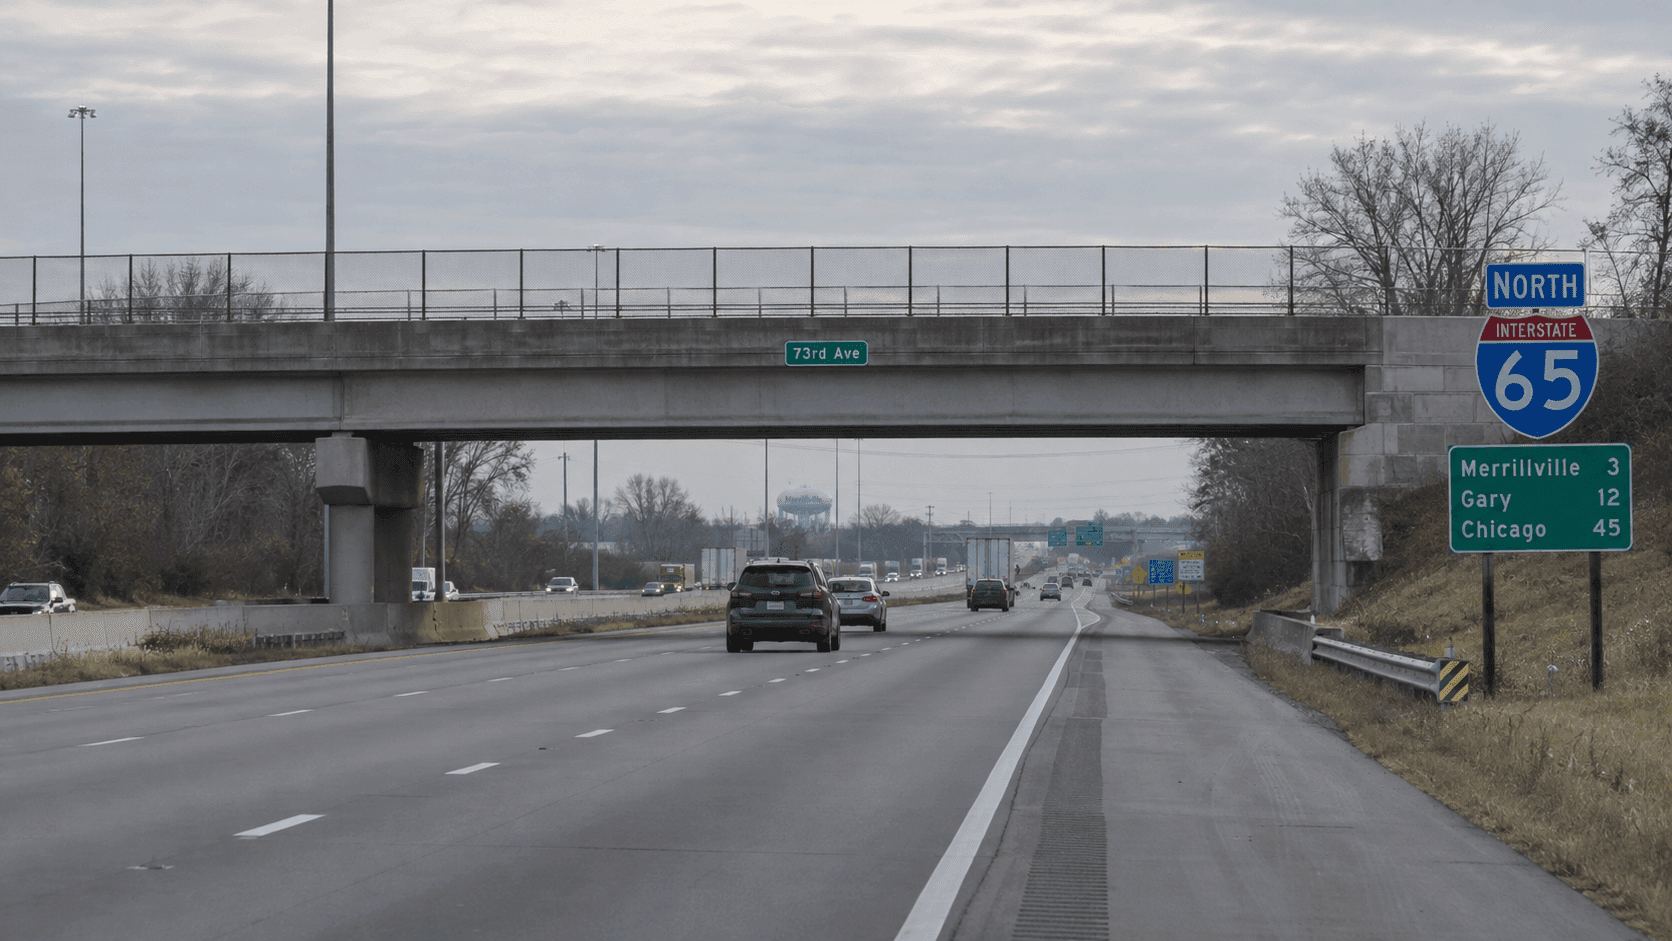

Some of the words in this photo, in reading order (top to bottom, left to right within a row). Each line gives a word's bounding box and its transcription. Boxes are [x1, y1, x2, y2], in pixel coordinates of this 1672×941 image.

[1494, 271, 1577, 299] NORTH
[1496, 322, 1577, 338] INTERSTATE
[793, 347, 826, 360] 73rd
[833, 346, 860, 360] Ave
[1495, 349, 1581, 411] 65
[1461, 458, 1580, 478] Merrillville
[1607, 457, 1620, 476] 3
[1461, 489, 1512, 512] Gary
[1597, 488, 1620, 507] 12
[1461, 519, 1547, 542] Chicago
[1592, 518, 1621, 537] 45
